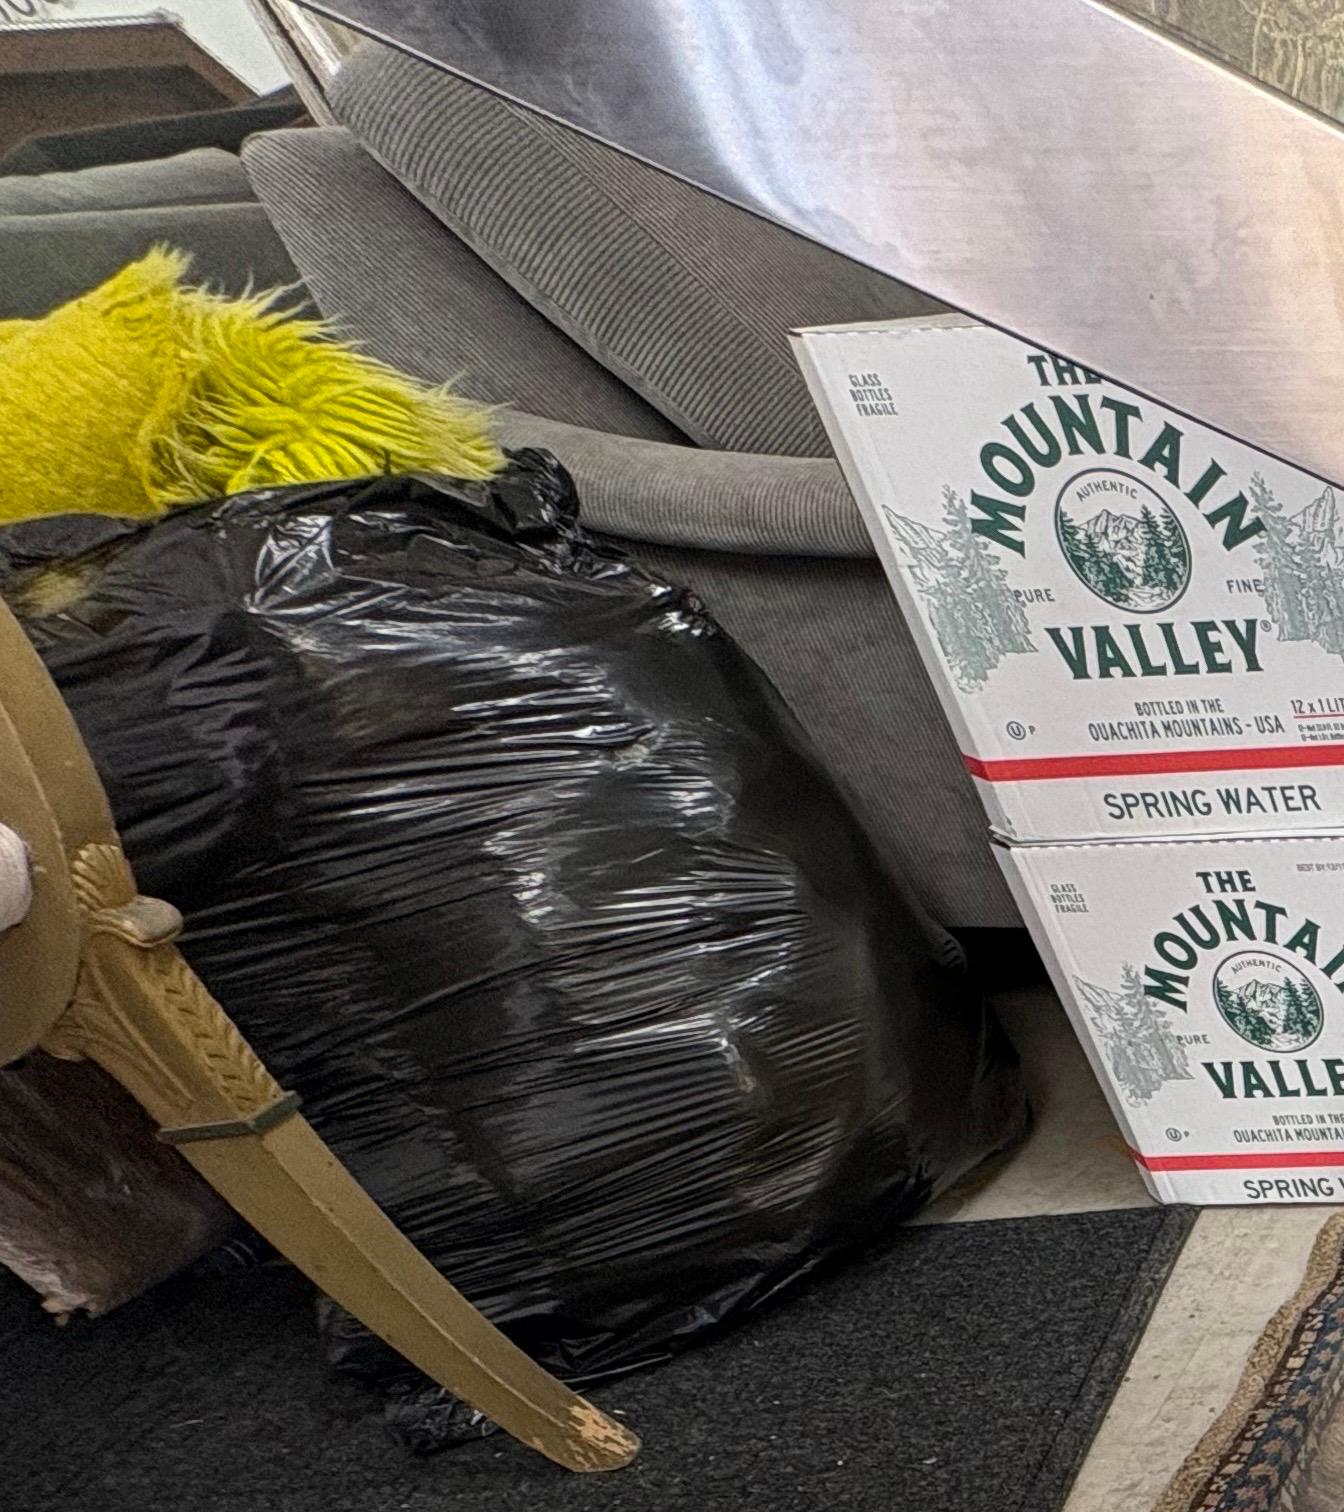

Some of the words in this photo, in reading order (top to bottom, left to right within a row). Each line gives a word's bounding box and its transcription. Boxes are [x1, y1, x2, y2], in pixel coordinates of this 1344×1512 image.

[848, 373, 881, 387] GLASS
[1027, 355, 1102, 386] THE
[849, 388, 893, 402] BOTTLES
[856, 402, 898, 416] FRAGILE
[971, 394, 1268, 559] MOUNTAIN
[1075, 480, 1138, 503] AUTHENTIC
[1014, 588, 1056, 602] PURE
[1227, 578, 1263, 594] FINE
[1134, 700, 1184, 716] BOTTLED
[1187, 699, 1199, 714] IN
[1201, 698, 1224, 713] THE
[1290, 699, 1305, 714] 12
[1088, 719, 1162, 742] OUACHITA
[1164, 717, 1244, 740] MOUNTAINS
[1254, 715, 1285, 734] USA
[1104, 788, 1212, 820] SPRING
[1217, 784, 1323, 815] WATER
[1196, 870, 1256, 893] THE
[1177, 1034, 1211, 1046] PURE
[1272, 1115, 1313, 1126] BOTTLED
[1316, 1114, 1326, 1124] IN
[1233, 1128, 1293, 1144] OUACHITA
[1243, 1177, 1334, 1199] SPRING
